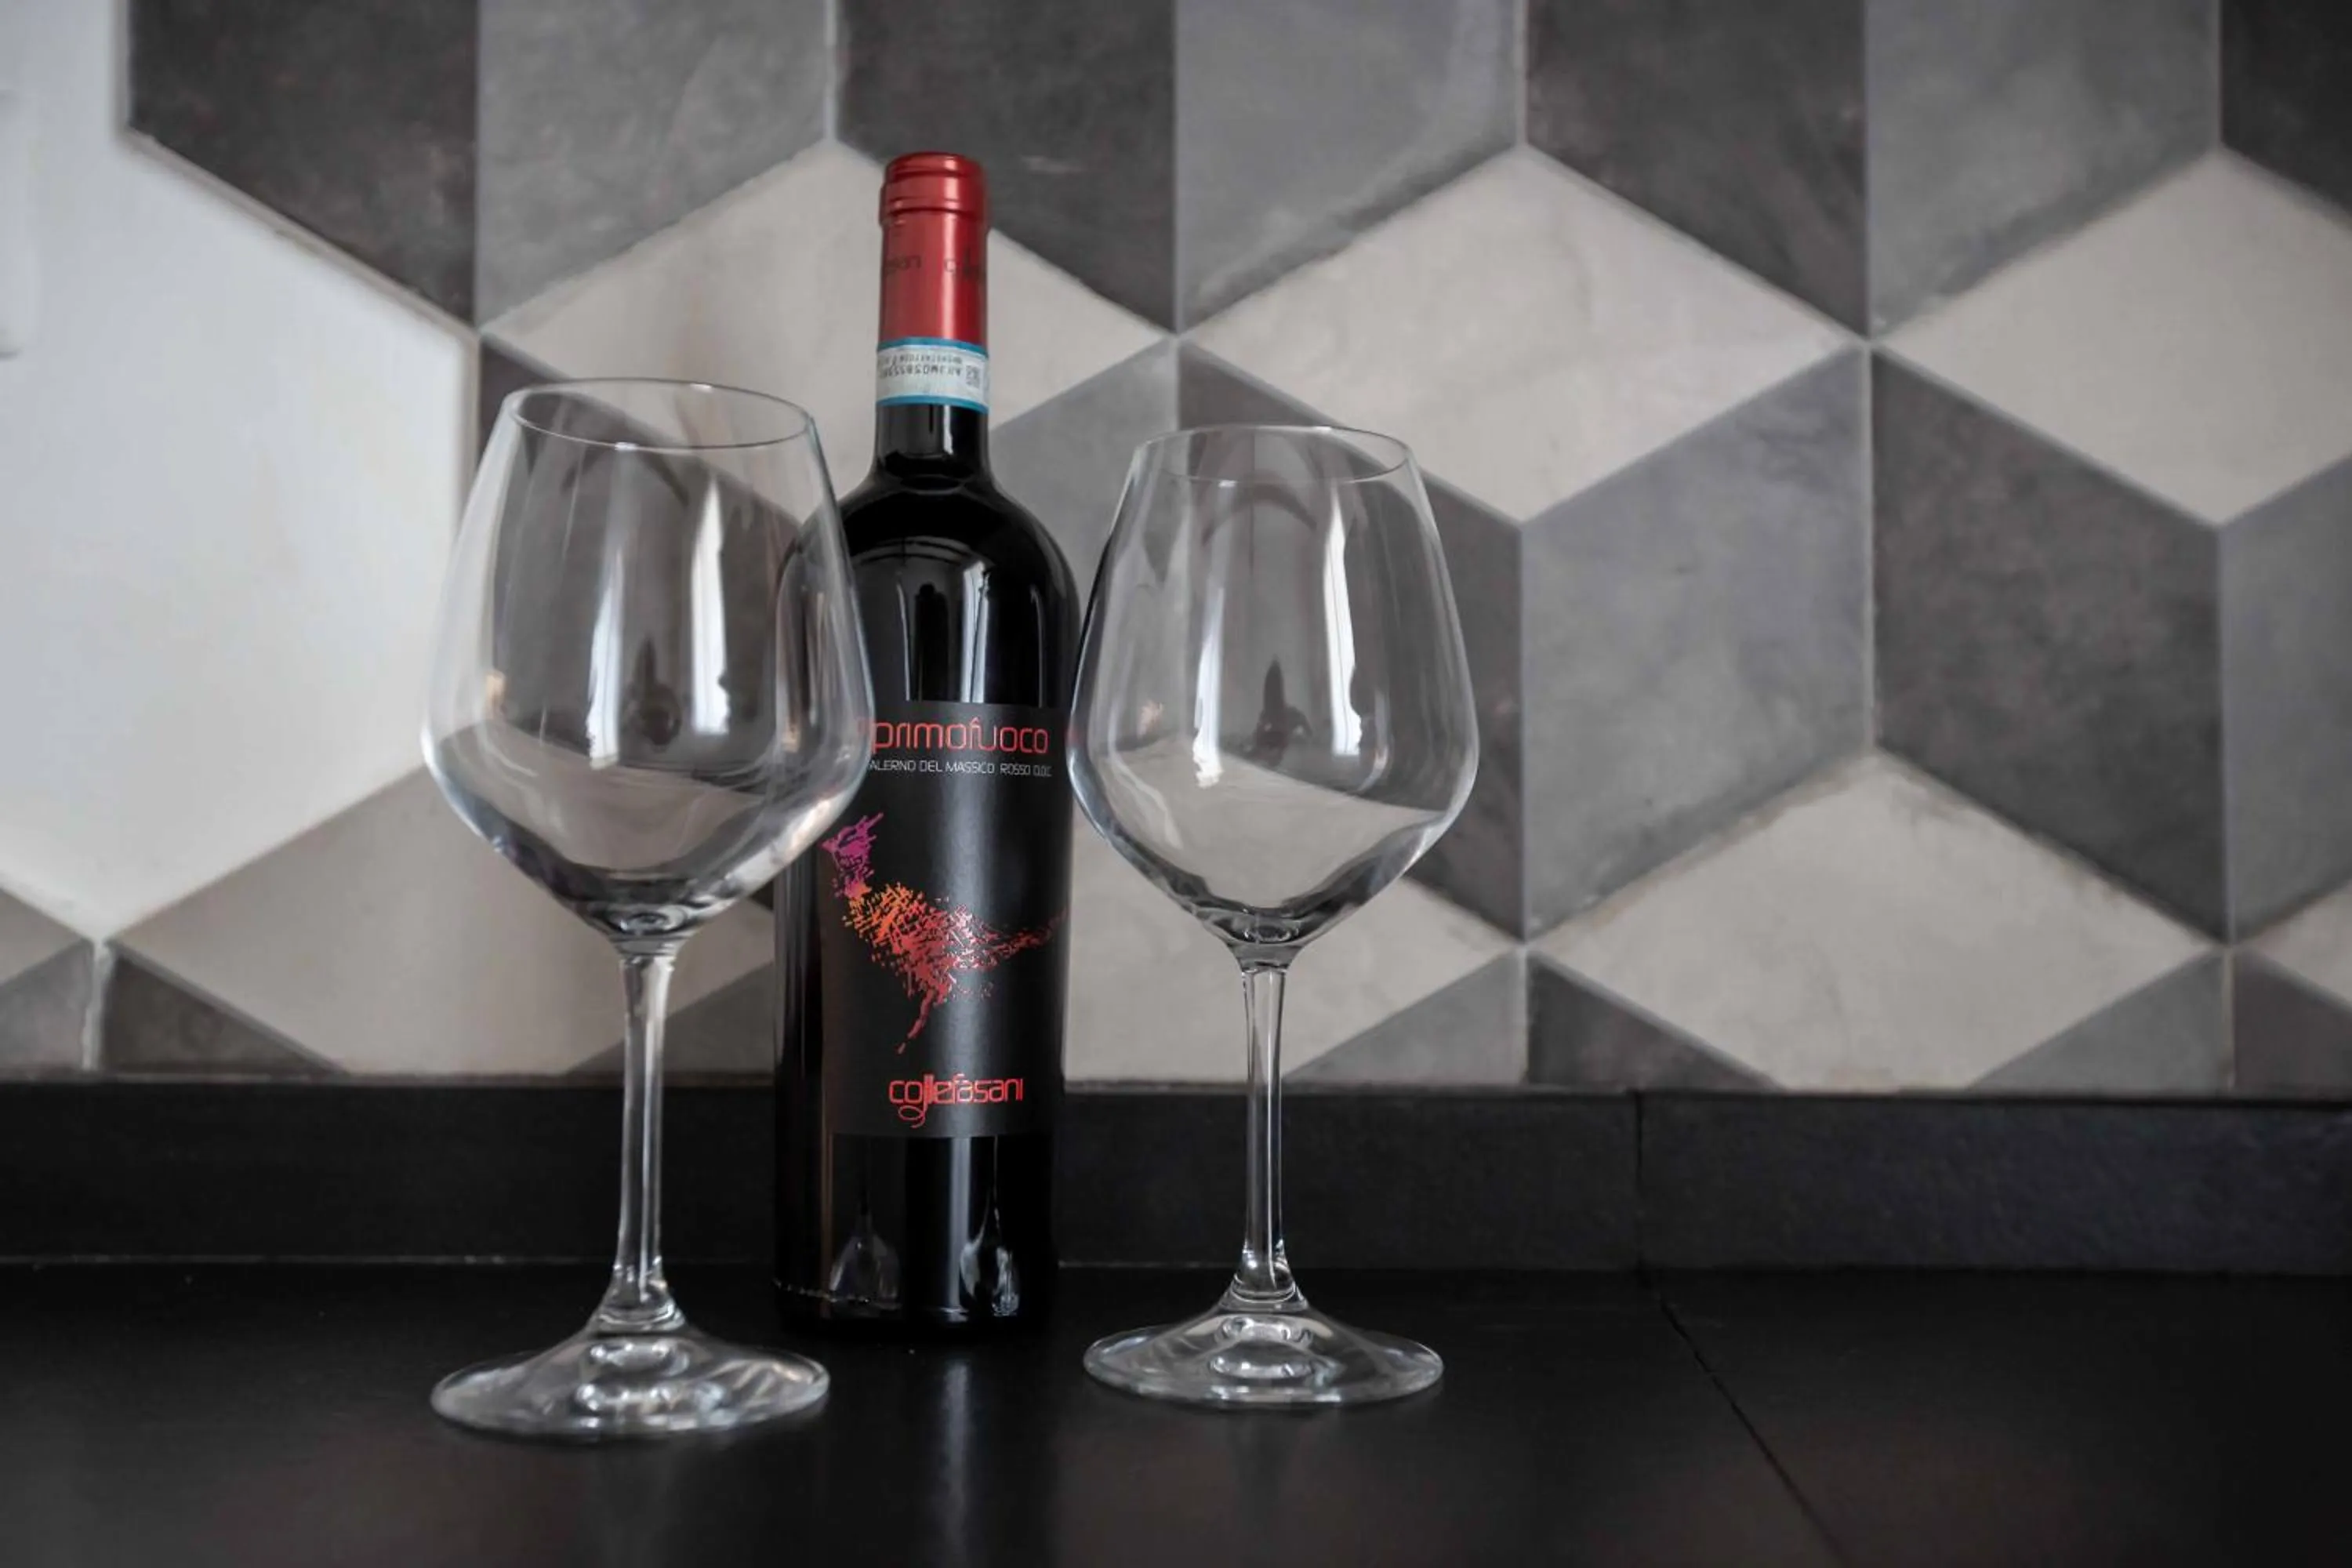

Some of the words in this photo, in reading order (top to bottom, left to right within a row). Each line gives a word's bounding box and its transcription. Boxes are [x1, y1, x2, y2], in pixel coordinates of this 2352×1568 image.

[871, 717, 1049, 753] primofuoco
[868, 759, 916, 772] ALERNO
[920, 760, 942, 773] DEL
[945, 760, 995, 774] MASSICO
[1000, 763, 1031, 776] ROSSO
[889, 1073, 1023, 1129] collefasani
